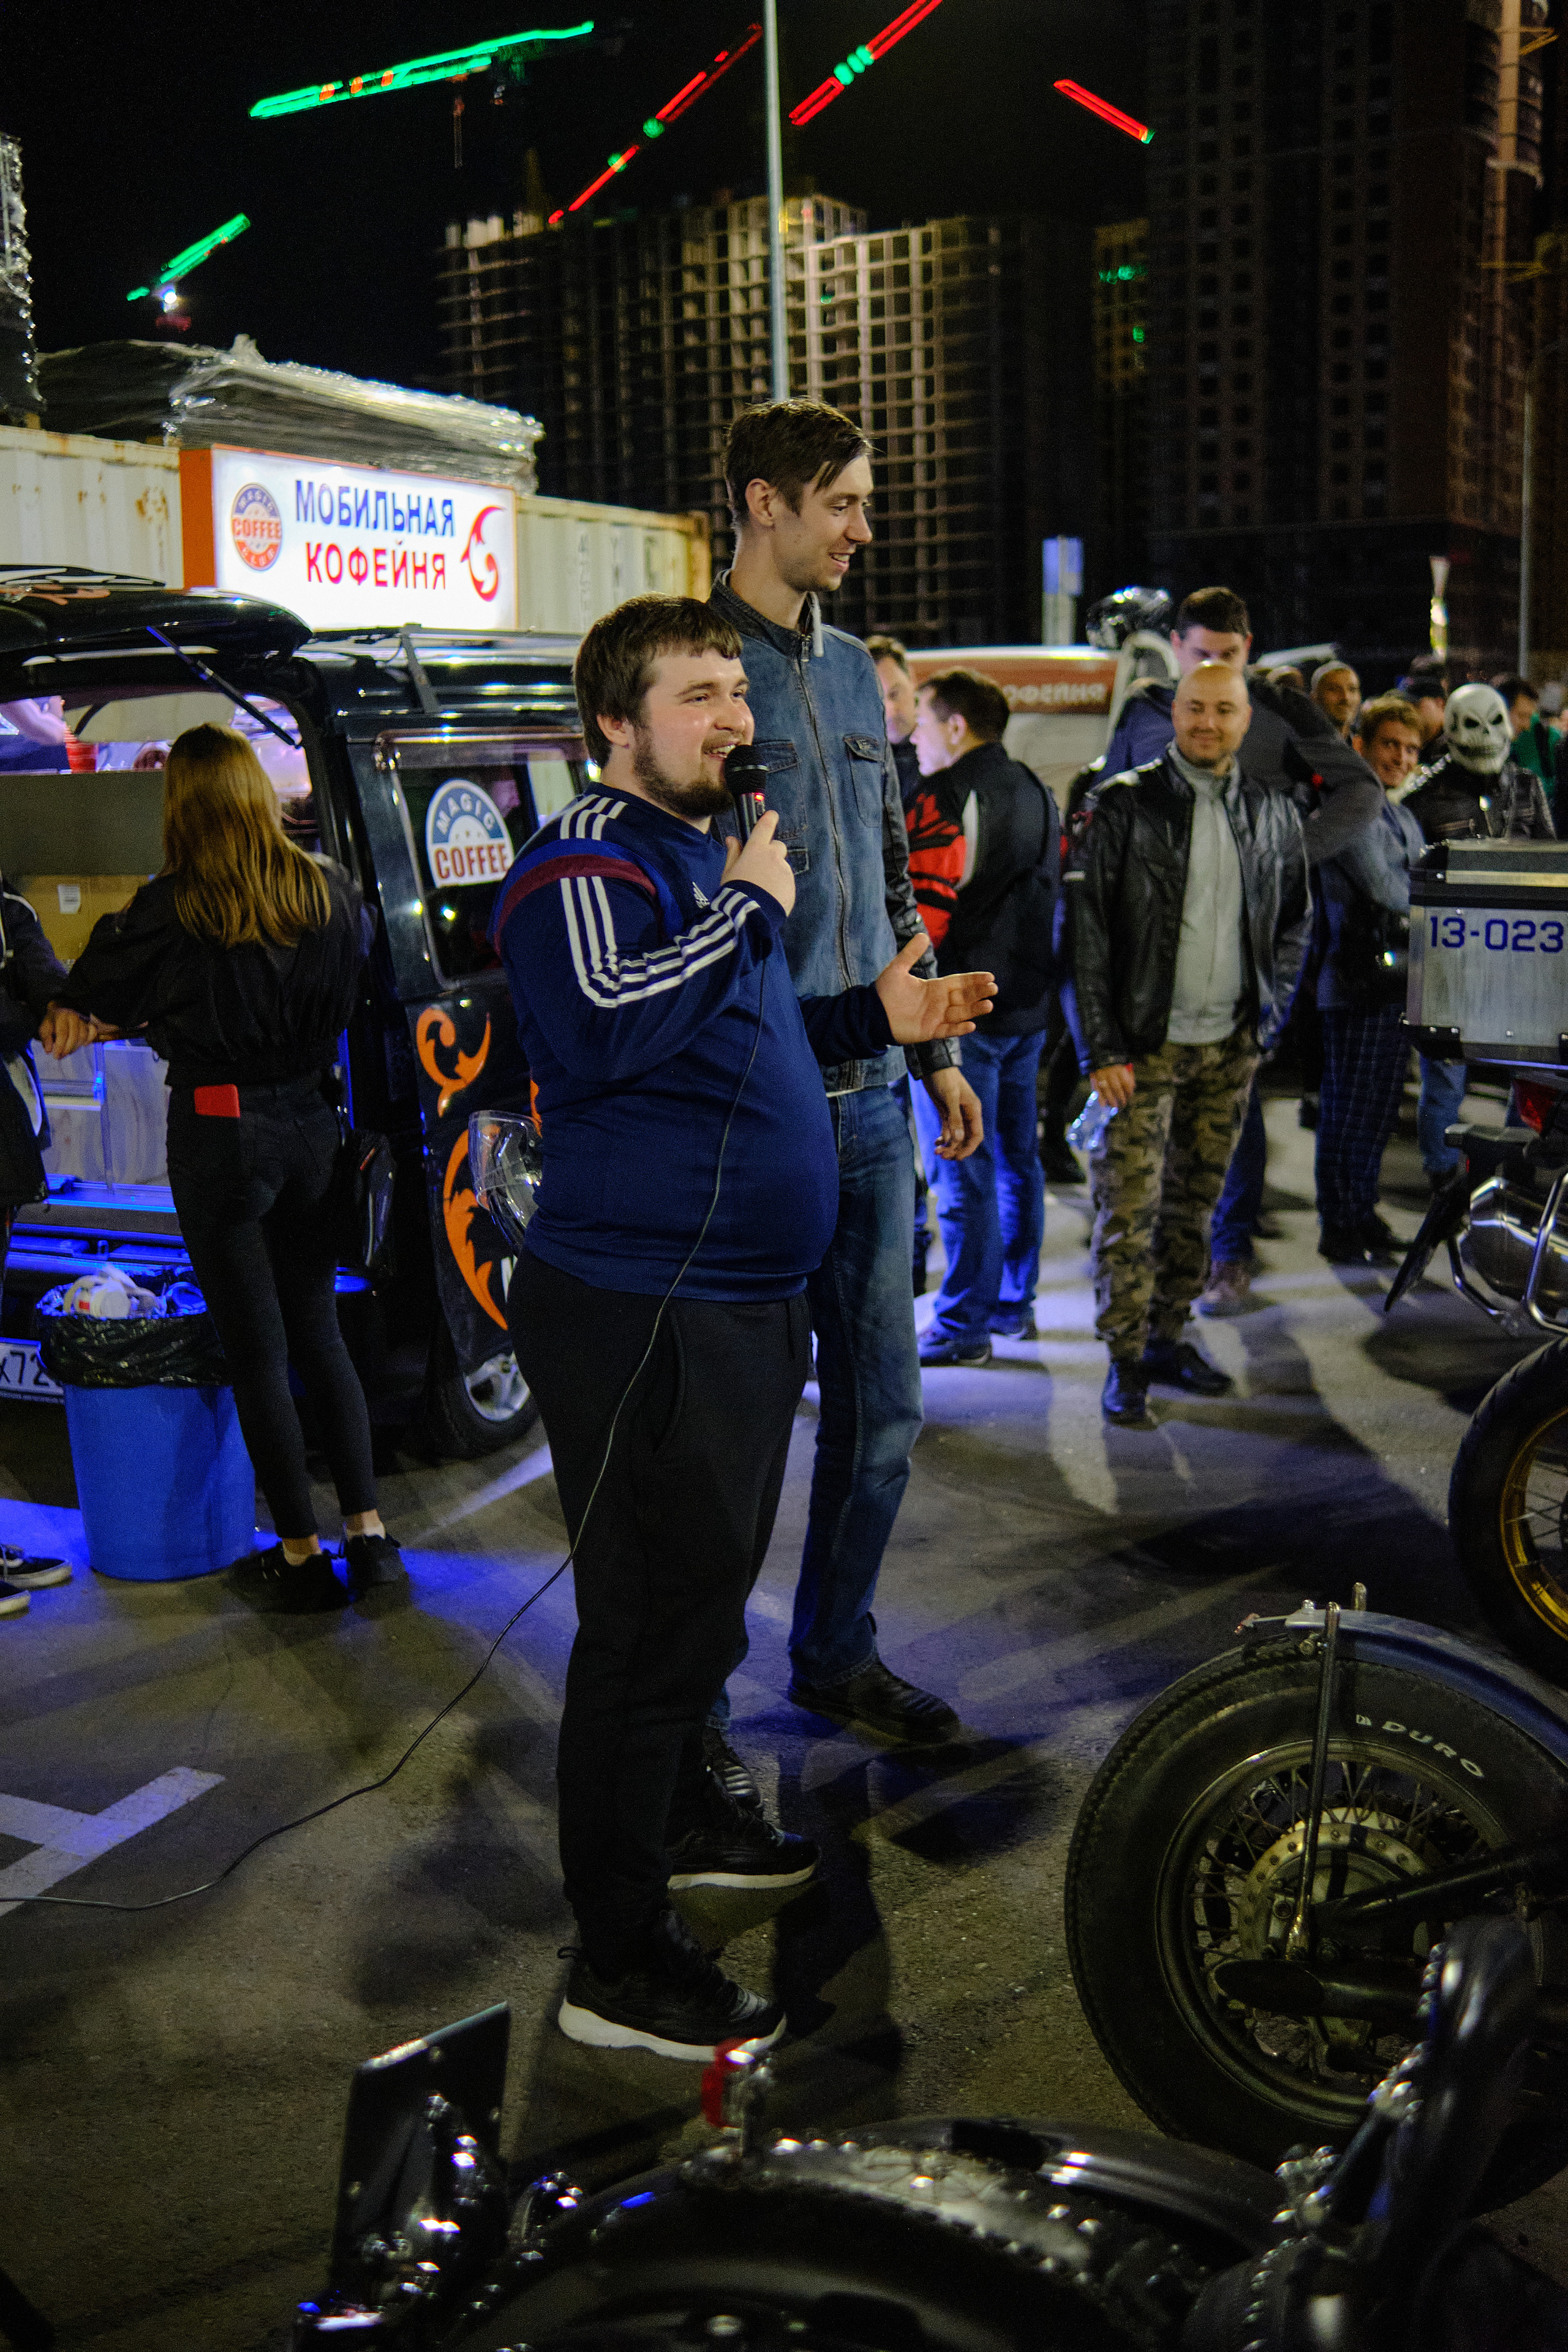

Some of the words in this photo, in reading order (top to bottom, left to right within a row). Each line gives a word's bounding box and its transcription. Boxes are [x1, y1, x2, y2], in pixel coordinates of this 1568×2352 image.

[232, 518, 281, 538] COFFEE
[295, 480, 455, 537] МОБИЛЬНАЯ
[306, 538, 446, 589] КОФЕЙНЯ
[436, 793, 496, 835] MAGIC
[434, 843, 508, 879] COFFEE
[1430, 916, 1564, 953] 13-023
[1381, 1721, 1484, 1777] DURO
